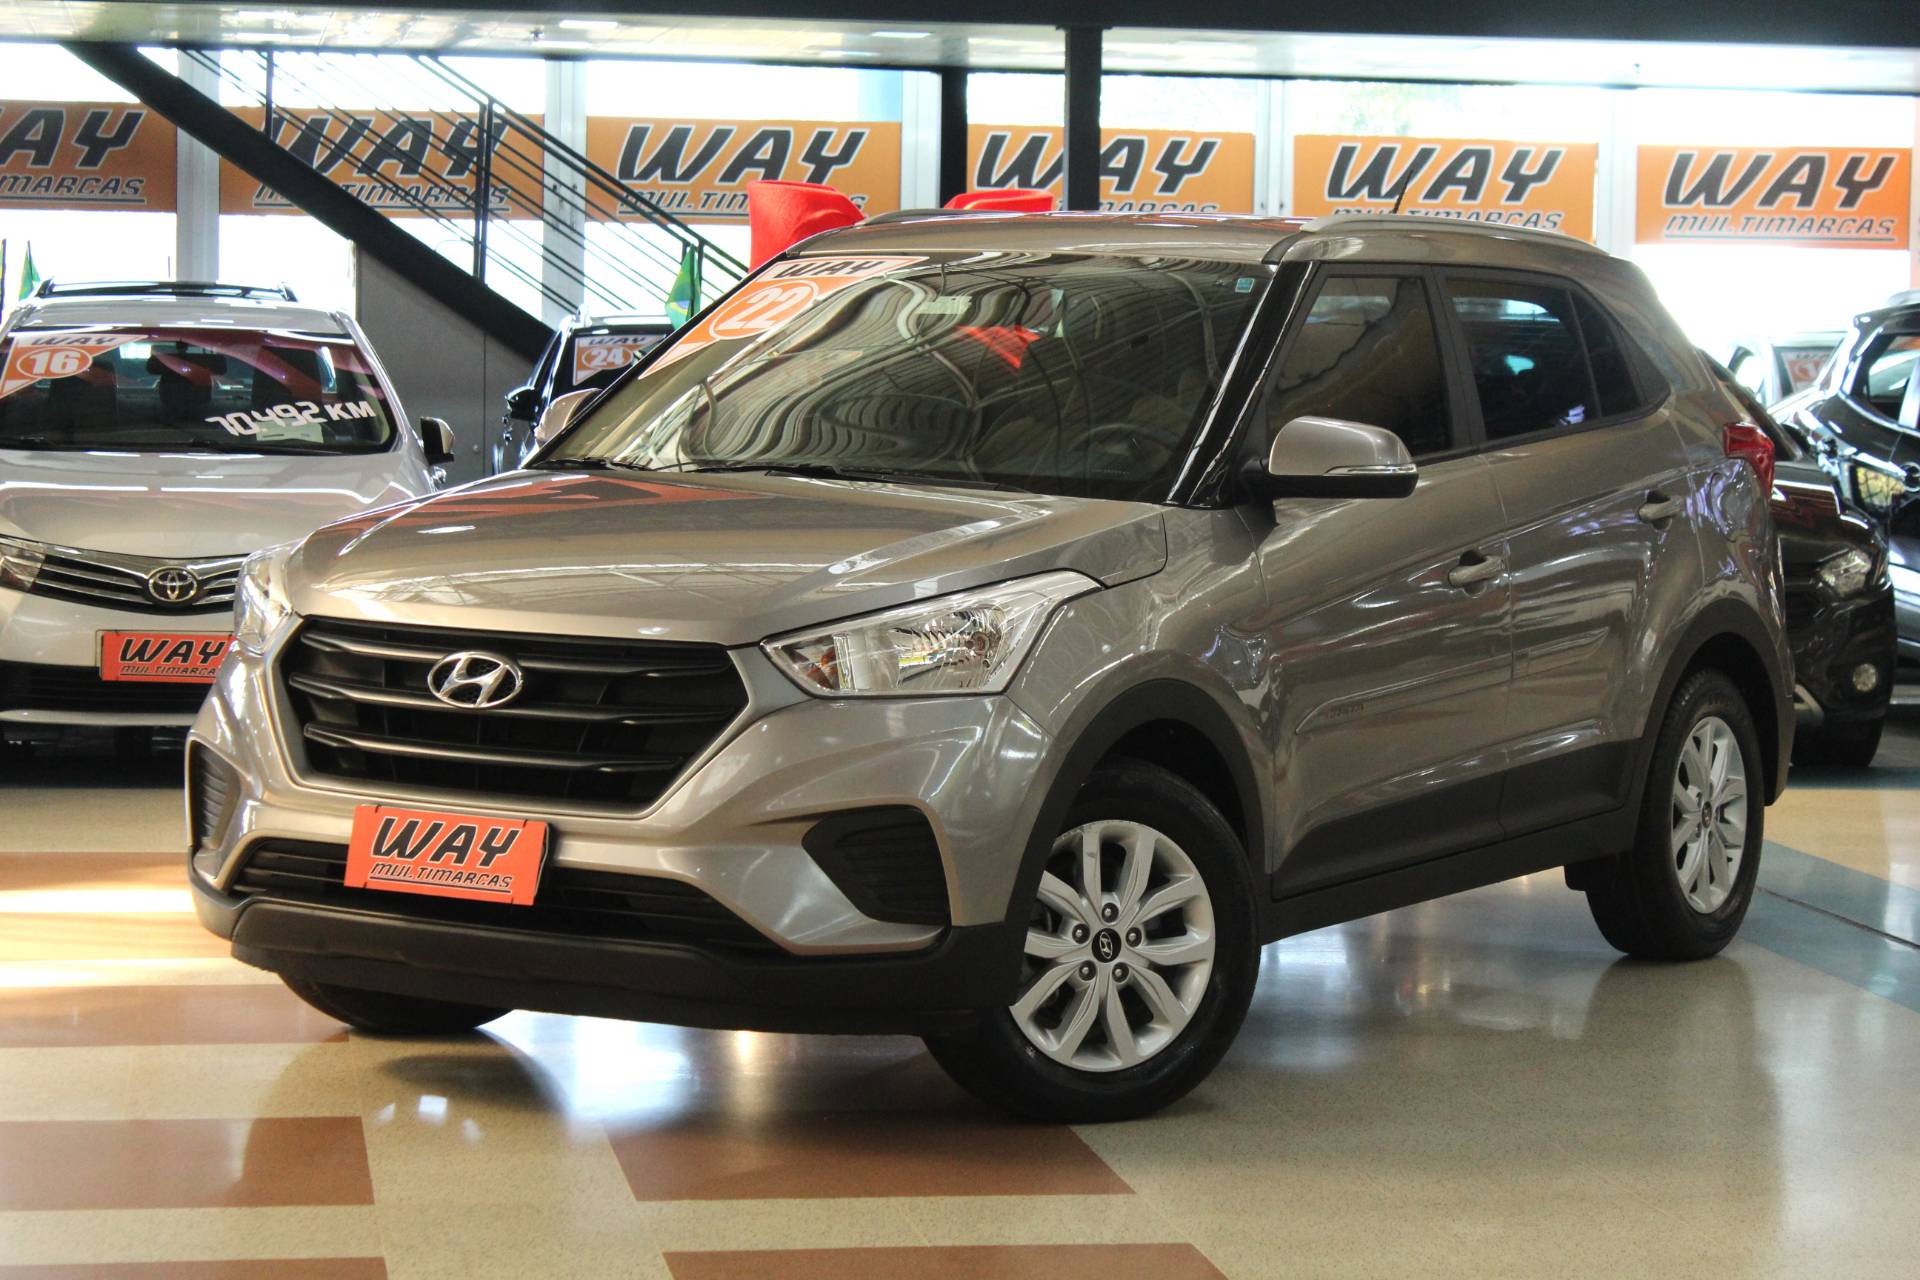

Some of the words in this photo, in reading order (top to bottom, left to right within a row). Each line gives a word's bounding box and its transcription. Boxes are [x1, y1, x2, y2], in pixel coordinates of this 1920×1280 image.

[0, 109, 146, 169] AY
[616, 124, 869, 185] WAY
[974, 131, 1221, 196] WAY
[1324, 142, 1567, 205] WAY
[1662, 151, 1900, 210] WAY
[1664, 214, 1897, 236] MULTIMARCAS
[773, 261, 886, 279] WAY
[715, 286, 812, 331] 22
[32, 337, 117, 345] WAY
[30, 350, 81, 375] 16
[590, 348, 625, 367] 24
[323, 400, 377, 421] KM
[119, 638, 227, 664] WAY
[120, 665, 217, 676] MULTIMARCA
[370, 816, 522, 869] WAY
[369, 862, 513, 889] MULTIMARCAS
